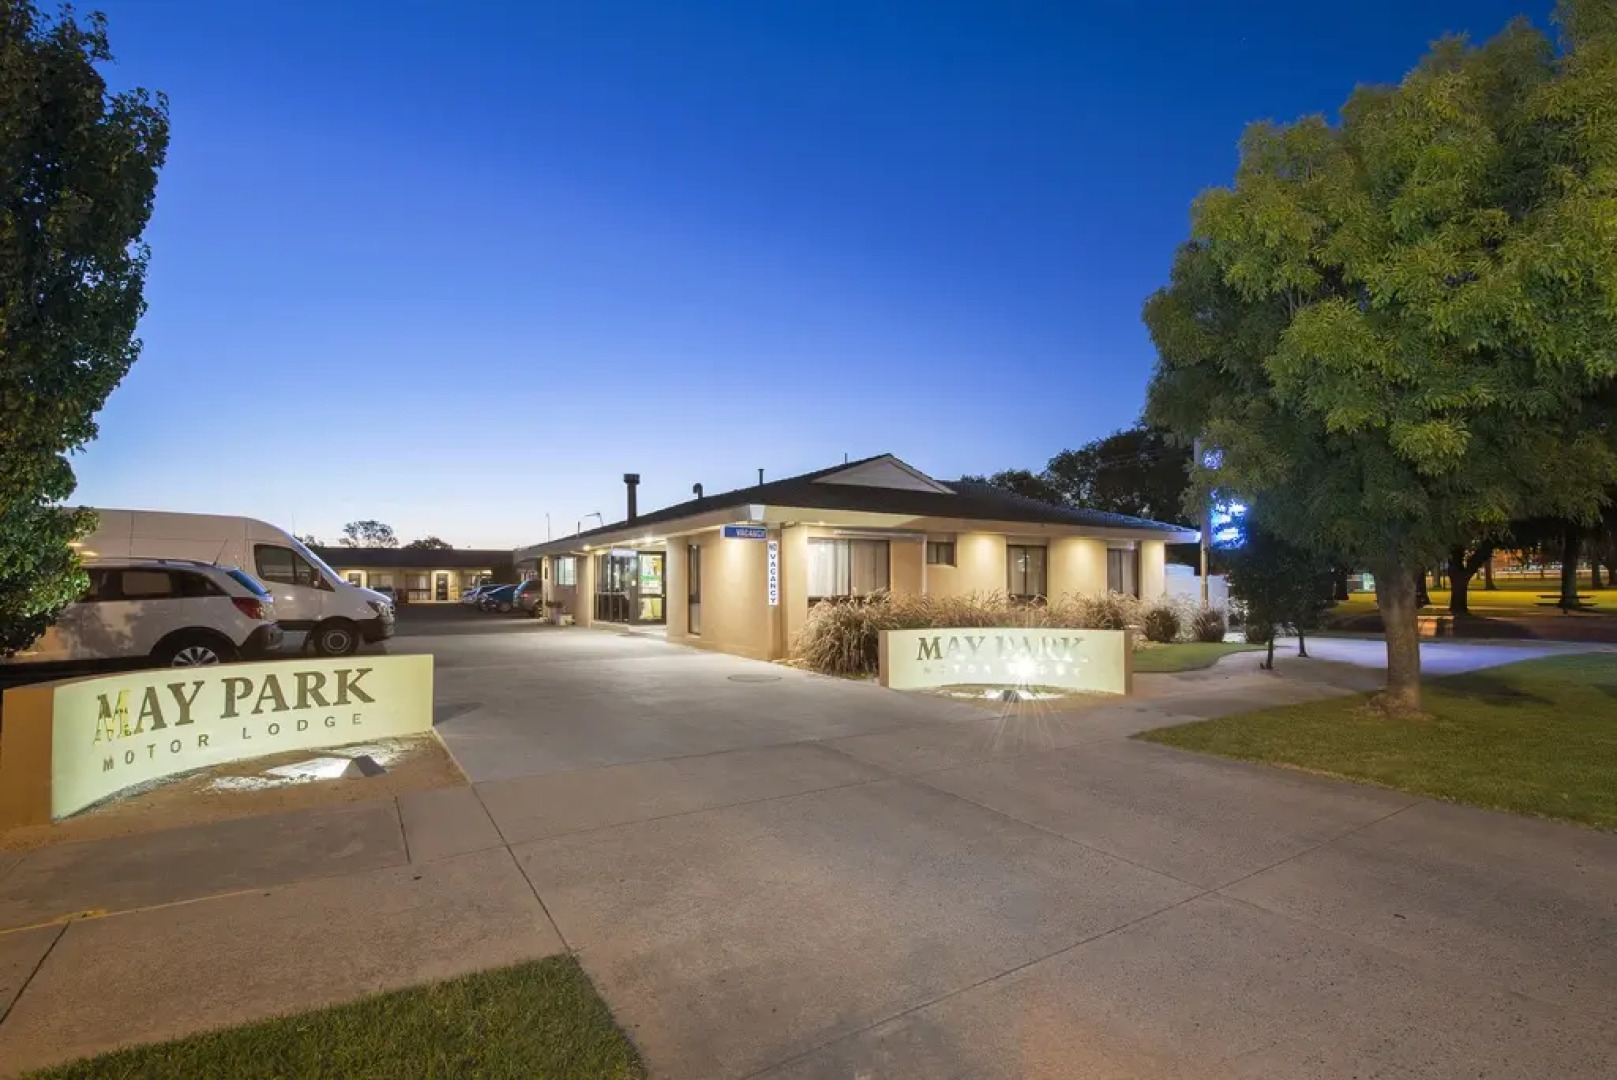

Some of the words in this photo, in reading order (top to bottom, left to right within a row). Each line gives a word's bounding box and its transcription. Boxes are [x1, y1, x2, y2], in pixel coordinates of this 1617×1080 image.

[917, 635, 986, 660] MAY
[995, 635, 1085, 660] PARK
[924, 663, 992, 677] TOR
[94, 680, 205, 742] MAY
[220, 668, 375, 719] PARK
[102, 733, 210, 772] MOTOR
[242, 713, 362, 740] LODGE
